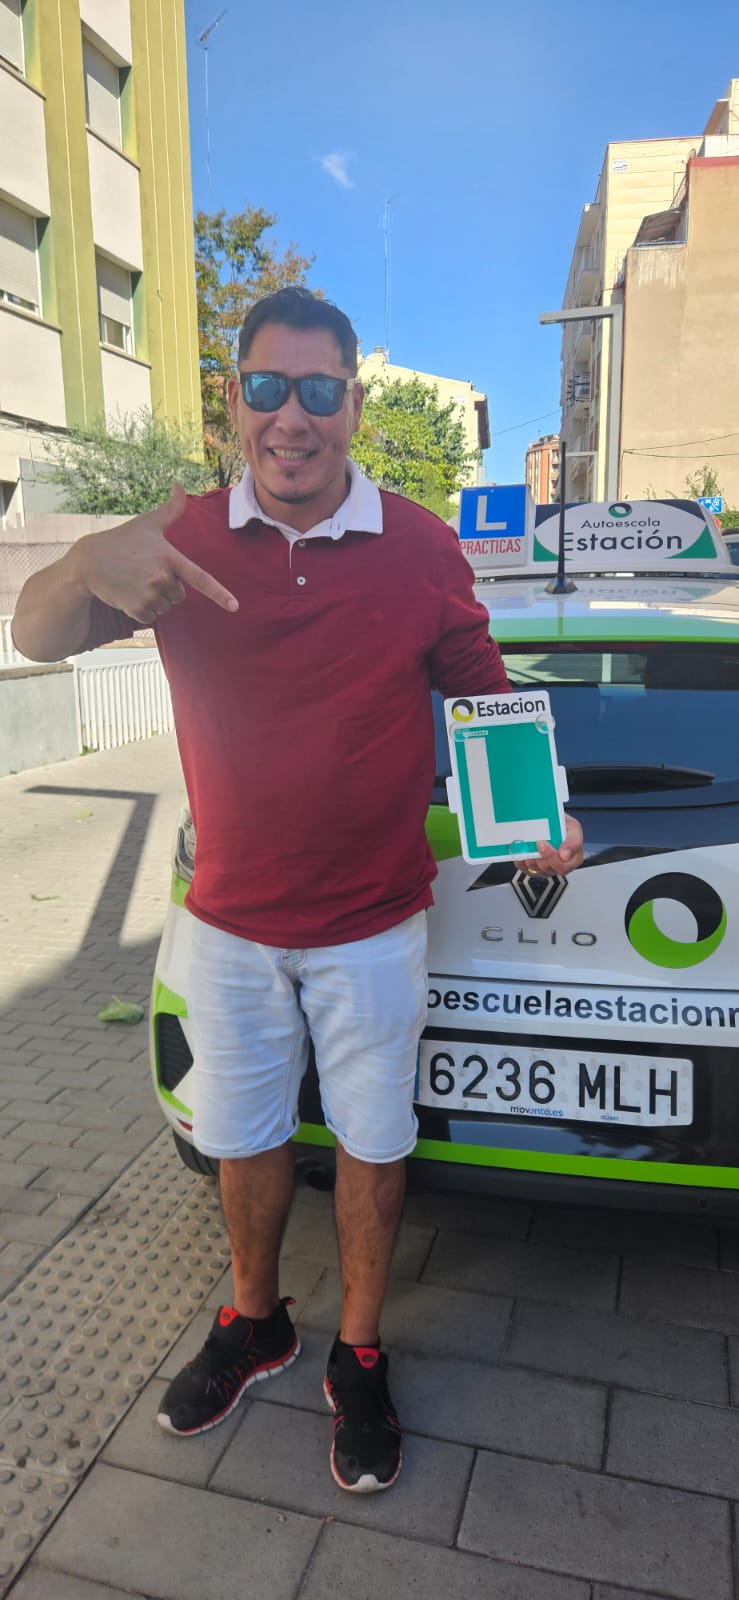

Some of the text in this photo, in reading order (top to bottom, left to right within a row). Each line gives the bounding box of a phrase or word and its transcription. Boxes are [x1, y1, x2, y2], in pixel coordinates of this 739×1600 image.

[476, 495, 507, 531] L
[580, 516, 661, 529] Autoescola
[460, 538, 521, 555] PRACTICAS
[563, 529, 683, 551] Estación
[477, 697, 546, 717] Estacion
[464, 737, 551, 848] L
[480, 926, 598, 947] CLIO
[430, 1052, 678, 1117] 6236 MLH
